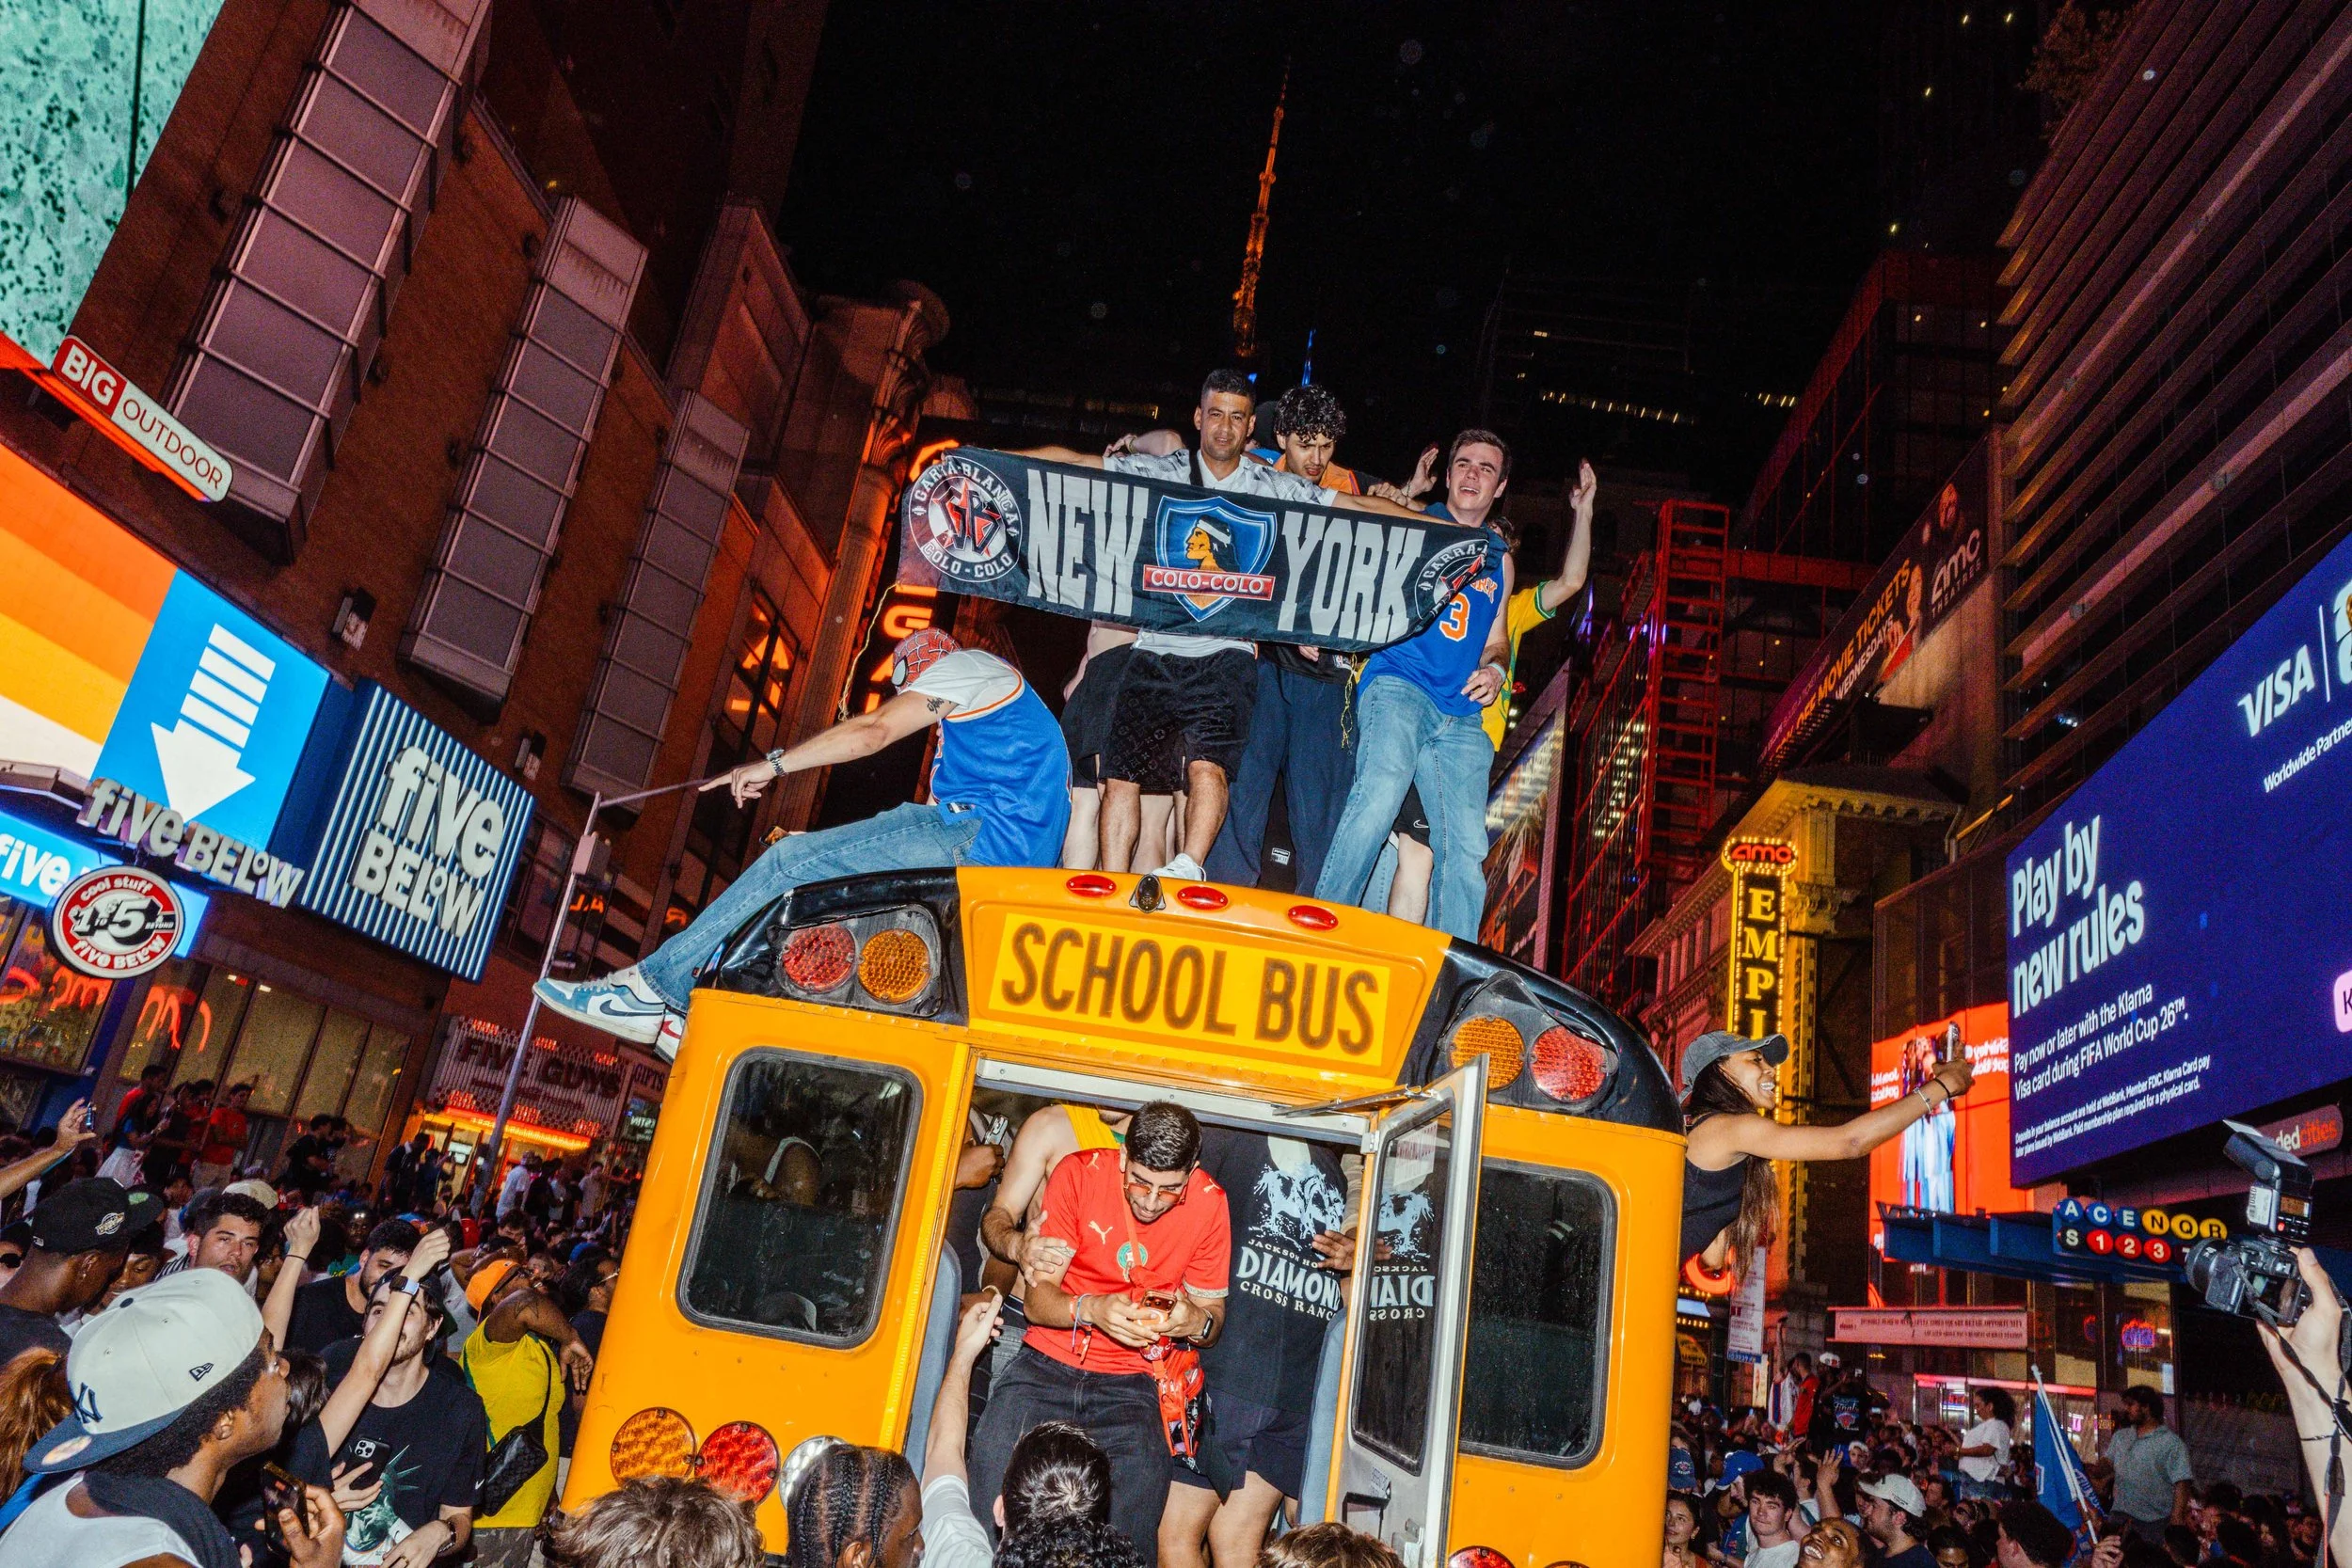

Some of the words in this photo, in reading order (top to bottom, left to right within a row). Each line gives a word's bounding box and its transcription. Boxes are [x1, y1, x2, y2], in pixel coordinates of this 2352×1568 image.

[61, 344, 117, 406] BIG
[122, 399, 223, 490] OUTDOOR
[1027, 468, 1150, 616] NEW
[1278, 510, 1426, 644] YORK
[1151, 569, 1264, 594] COLO-COLO
[1422, 543, 1487, 578] GARRA-
[1439, 592, 1470, 642] 3
[1818, 639, 1854, 705] MOVIE
[1856, 557, 1911, 651] TICKETS
[2237, 644, 2315, 737] VISA
[2263, 743, 2317, 793] Worldwide
[79, 778, 188, 858] five
[378, 746, 504, 879] five
[80, 877, 111, 902] cool
[113, 876, 153, 894] stuff
[1730, 843, 1793, 863] amc
[2012, 848, 2060, 937] Play
[2065, 815, 2101, 900] by
[1001, 922, 1236, 1037] SCHOOL
[1255, 957, 1379, 1055] BUS
[1741, 887, 1778, 1039] EMPI
[2013, 932, 2070, 1019] new
[2070, 880, 2145, 983] rules
[2014, 1051, 2029, 1074] Pay
[2029, 1041, 2046, 1065] now
[2047, 1037, 2056, 1055] or
[2057, 1023, 2078, 1051] later
[2078, 1011, 2099, 1038] with
[2100, 1002, 2117, 1027] the
[2119, 984, 2153, 1018] Klarna
[2014, 1080, 2032, 1101] Visa
[2031, 1065, 2051, 1088] card
[2052, 1053, 2080, 1079] during
[2080, 1039, 2104, 1070] FIFA
[2104, 1022, 2134, 1057] World
[2135, 1017, 2158, 1042] Cup
[1248, 1239, 1300, 1262] JACKSON
[2064, 1200, 2079, 1217] A
[2093, 1206, 2107, 1223] C
[2122, 1210, 2135, 1227] E
[2151, 1215, 2164, 1231] N
[2179, 1221, 2193, 1236] Q
[2209, 1225, 2222, 1240] R
[2065, 1229, 2079, 1246] S
[2095, 1234, 2105, 1251] 1
[2123, 1238, 2136, 1255] 2
[2153, 1243, 2165, 1259] 3
[1236, 1246, 1341, 1311] DIAMOND
[1240, 1281, 1288, 1307] CROSS
[1295, 1301, 1336, 1322] RANC
